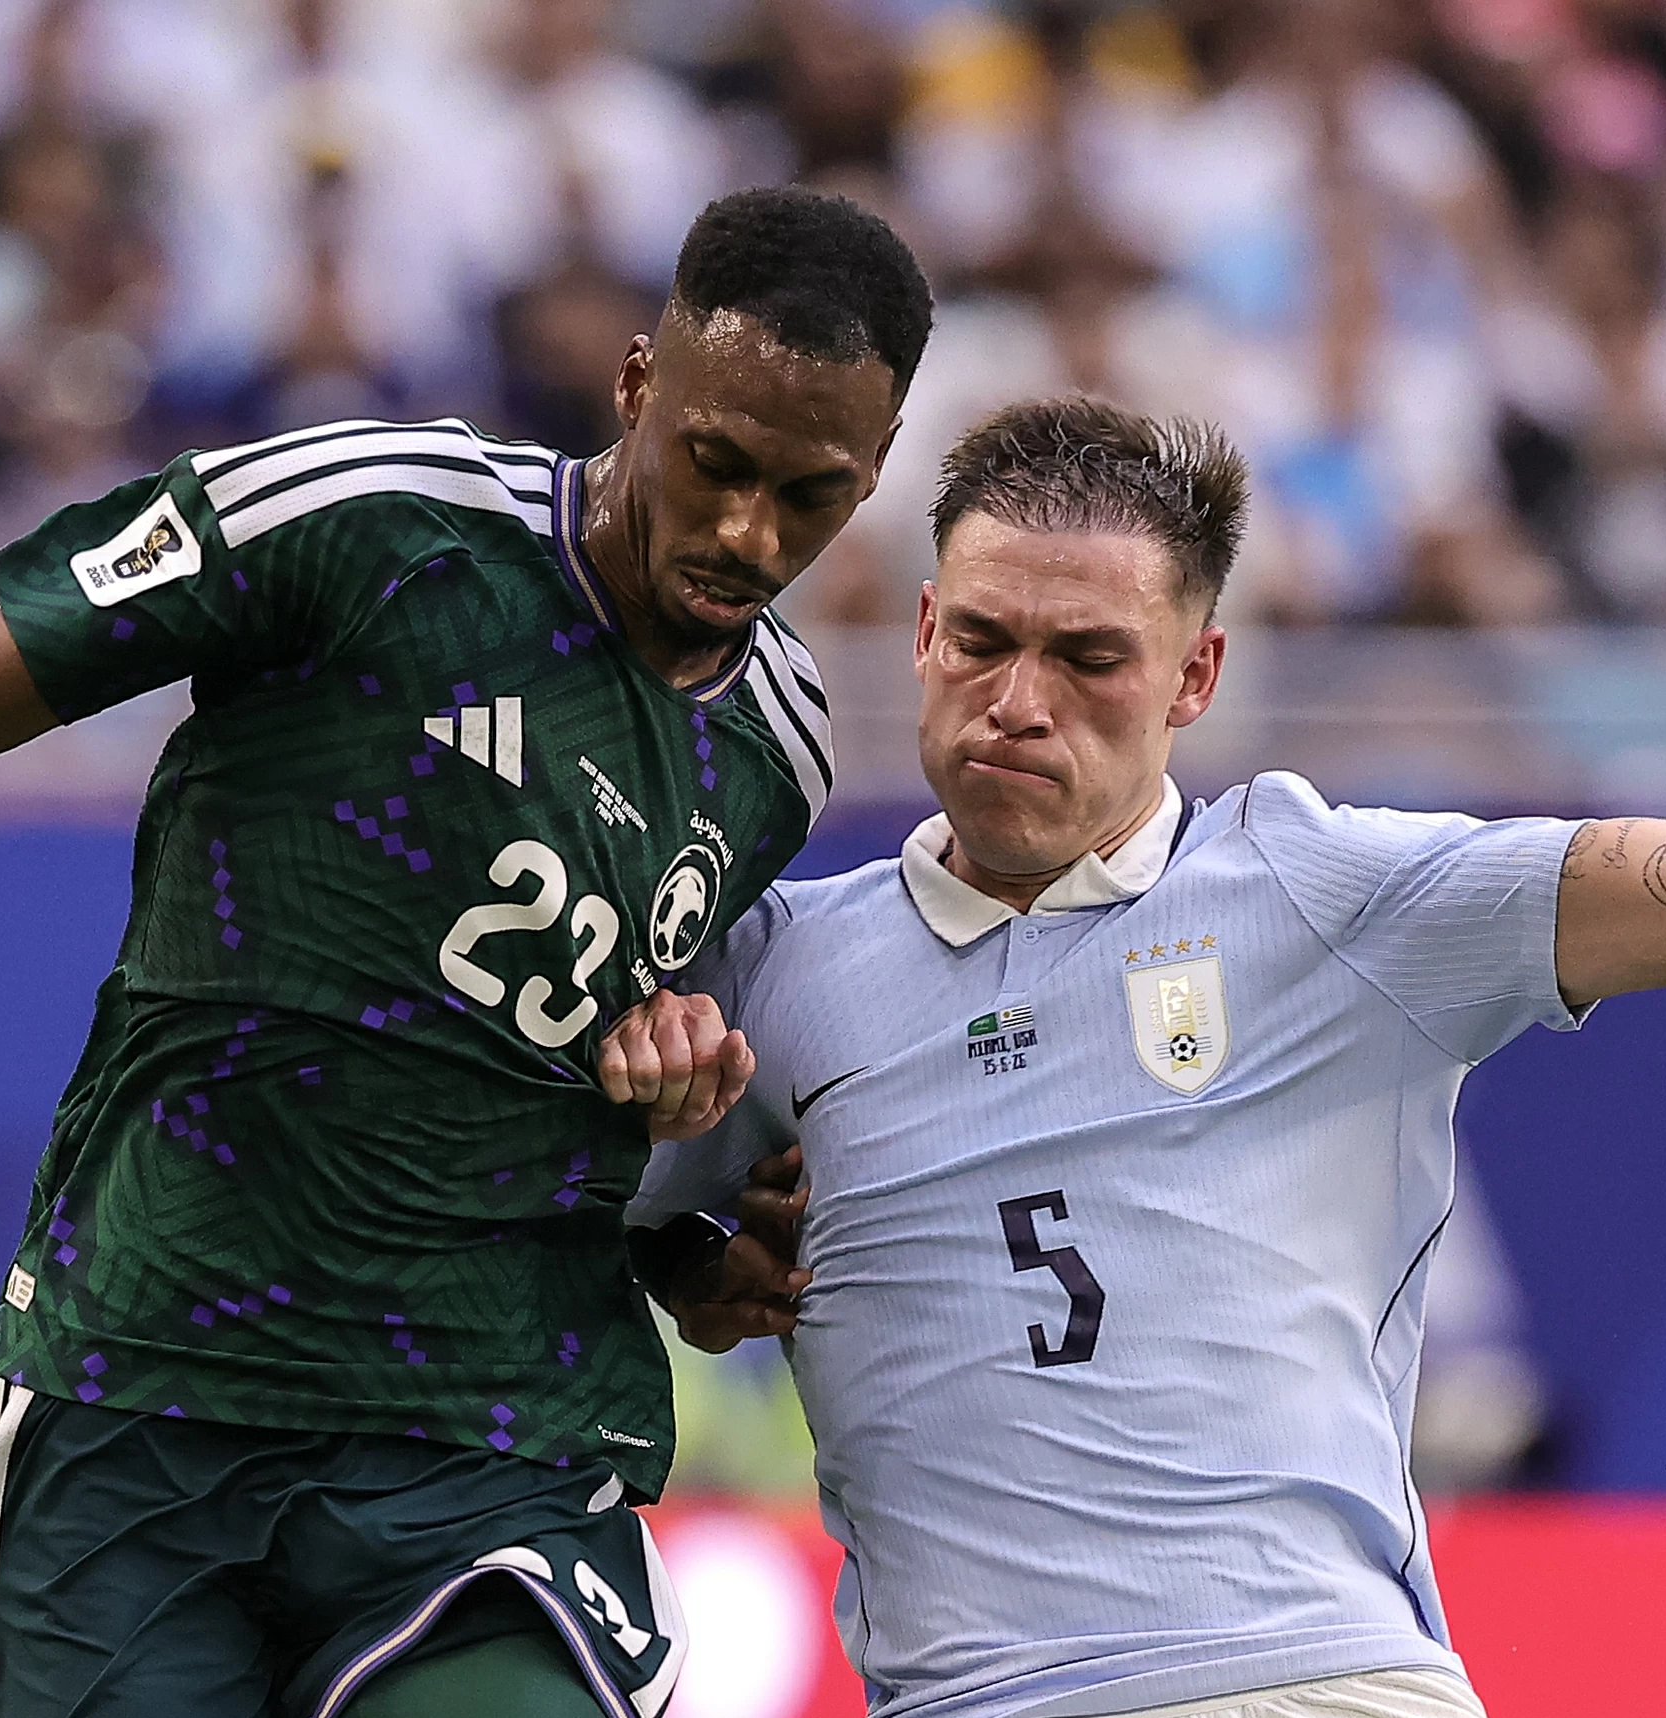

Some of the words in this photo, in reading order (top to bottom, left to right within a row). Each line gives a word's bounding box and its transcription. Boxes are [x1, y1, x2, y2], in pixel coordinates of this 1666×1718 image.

[86, 566, 107, 589] 2026
[440, 840, 620, 1047] 23
[997, 1189, 1105, 1368] 5
